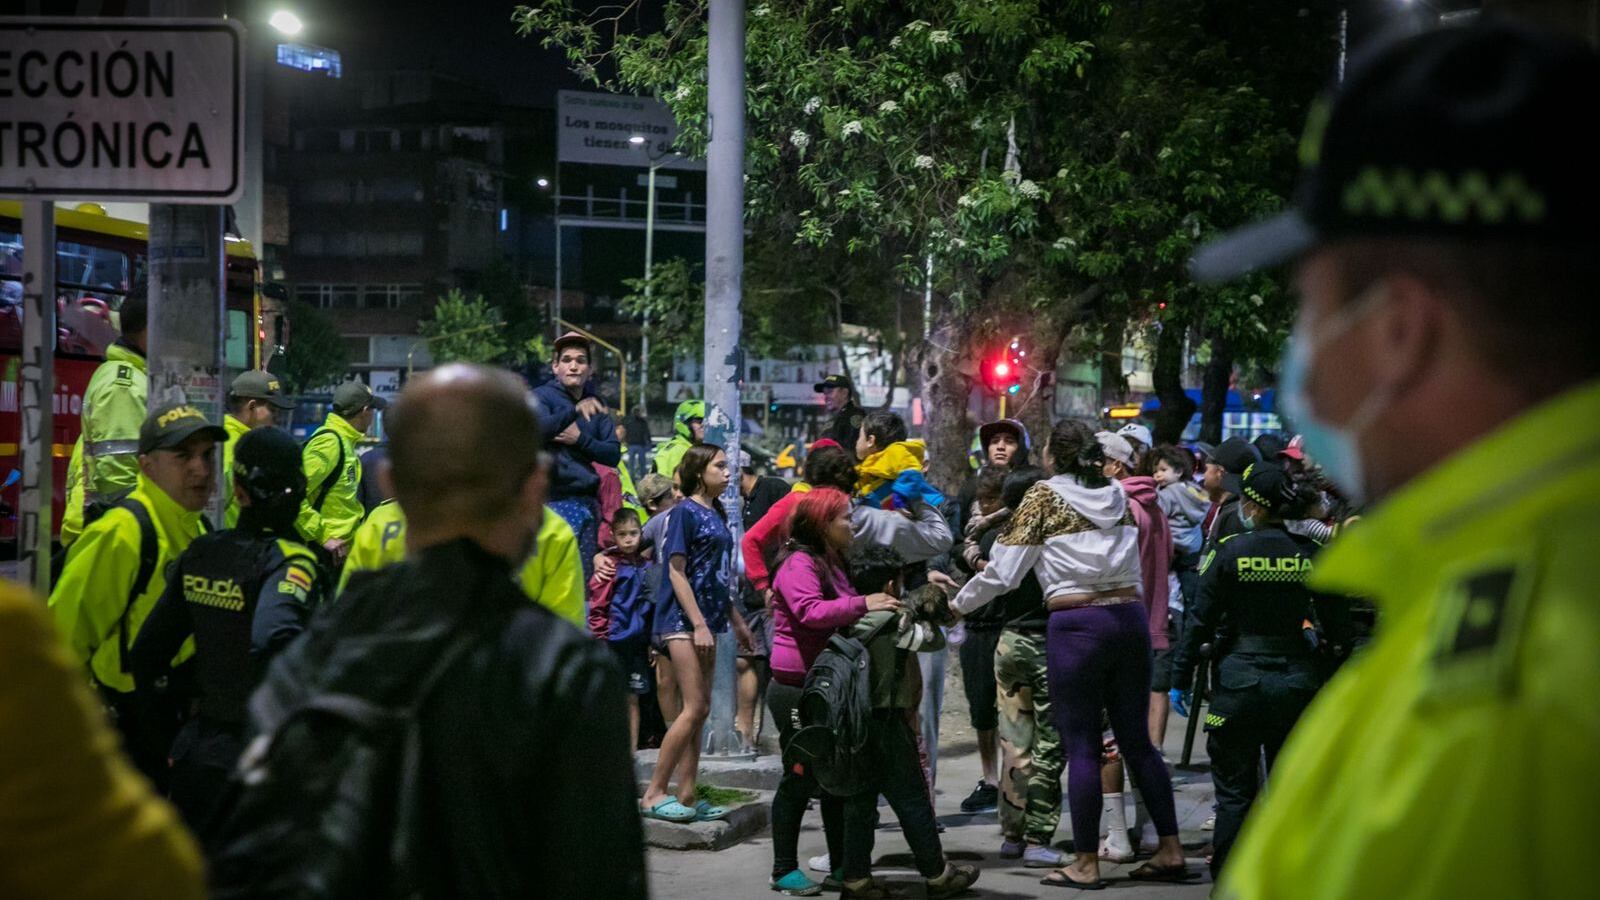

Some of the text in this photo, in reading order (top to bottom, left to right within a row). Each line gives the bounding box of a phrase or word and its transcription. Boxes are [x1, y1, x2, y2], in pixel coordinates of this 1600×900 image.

[565, 115, 668, 135] Los mosquitos
[1237, 552, 1313, 572] POLICÍA
[183, 574, 244, 600] POLICÍA
